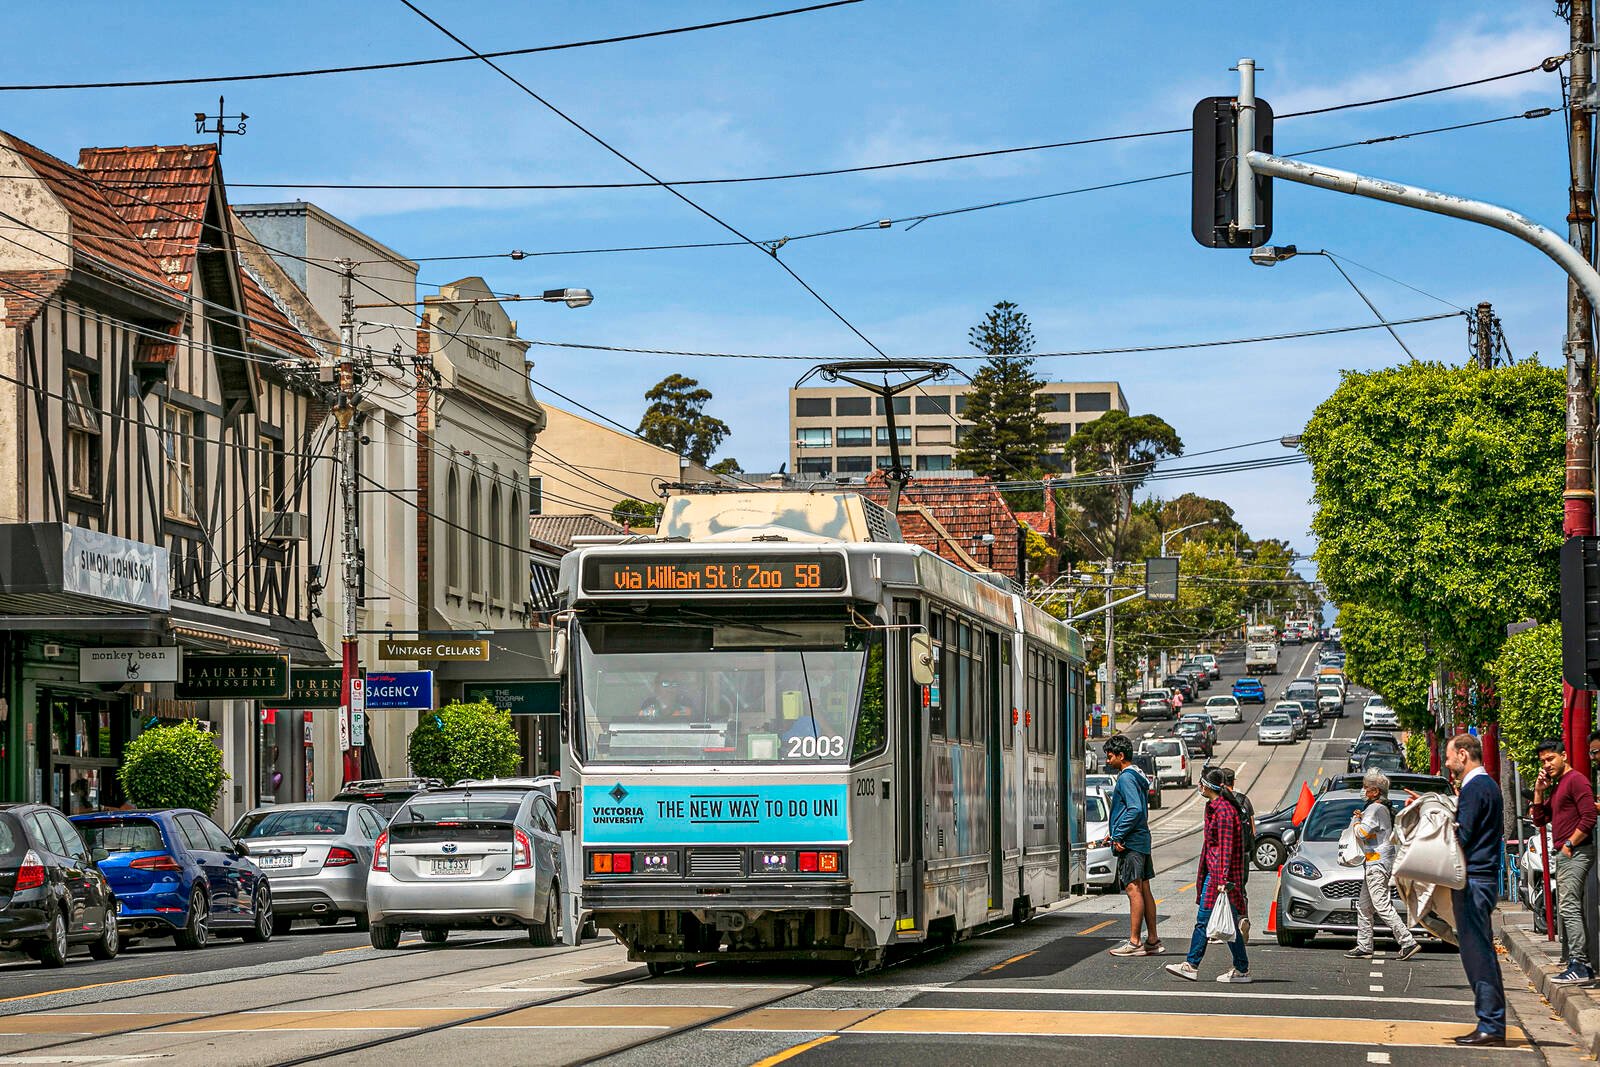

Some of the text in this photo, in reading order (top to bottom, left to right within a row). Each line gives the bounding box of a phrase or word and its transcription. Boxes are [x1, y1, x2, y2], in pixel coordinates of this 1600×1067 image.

[81, 550, 151, 583] SIMON JOHNSON
[614, 566, 642, 589] via
[647, 565, 700, 589] William
[705, 565, 727, 589] St
[747, 565, 782, 589] Zoo
[795, 564, 820, 588] 58
[92, 650, 165, 660] monkey bean
[188, 667, 276, 677] LAURENT
[788, 736, 844, 757] 2003
[856, 778, 875, 796] 2003
[592, 807, 644, 816] VICTORIA
[657, 799, 838, 818] THE NEW WAY TO DO UNI
[593, 816, 644, 824] UNIVERSITY
